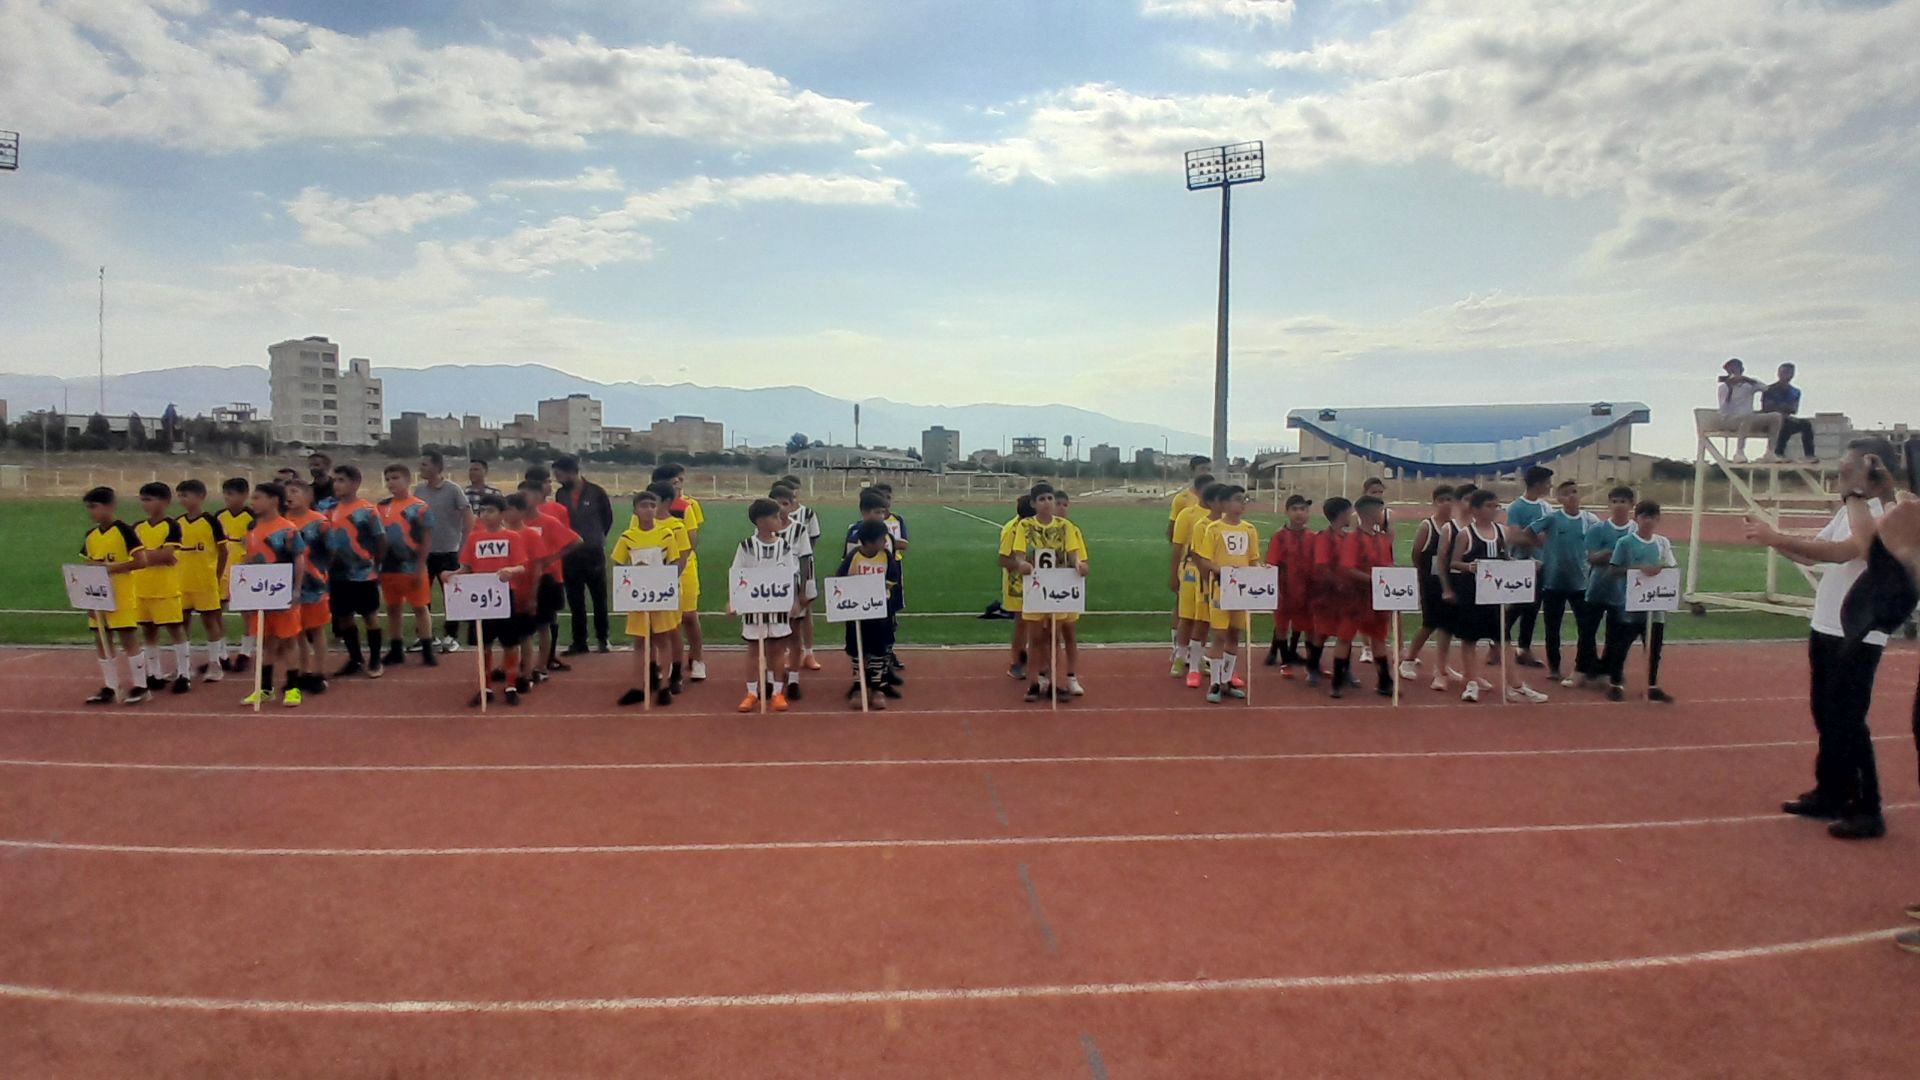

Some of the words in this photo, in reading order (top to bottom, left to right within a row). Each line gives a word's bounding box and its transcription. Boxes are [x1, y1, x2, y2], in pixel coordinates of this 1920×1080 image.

[478, 541, 506, 556] ۷۹۷
[1227, 535, 1243, 551] 61
[1038, 551, 1053, 569] 6
[250, 578, 287, 597] خواف
[631, 582, 675, 603] فیروزه
[469, 588, 503, 608] زاوه
